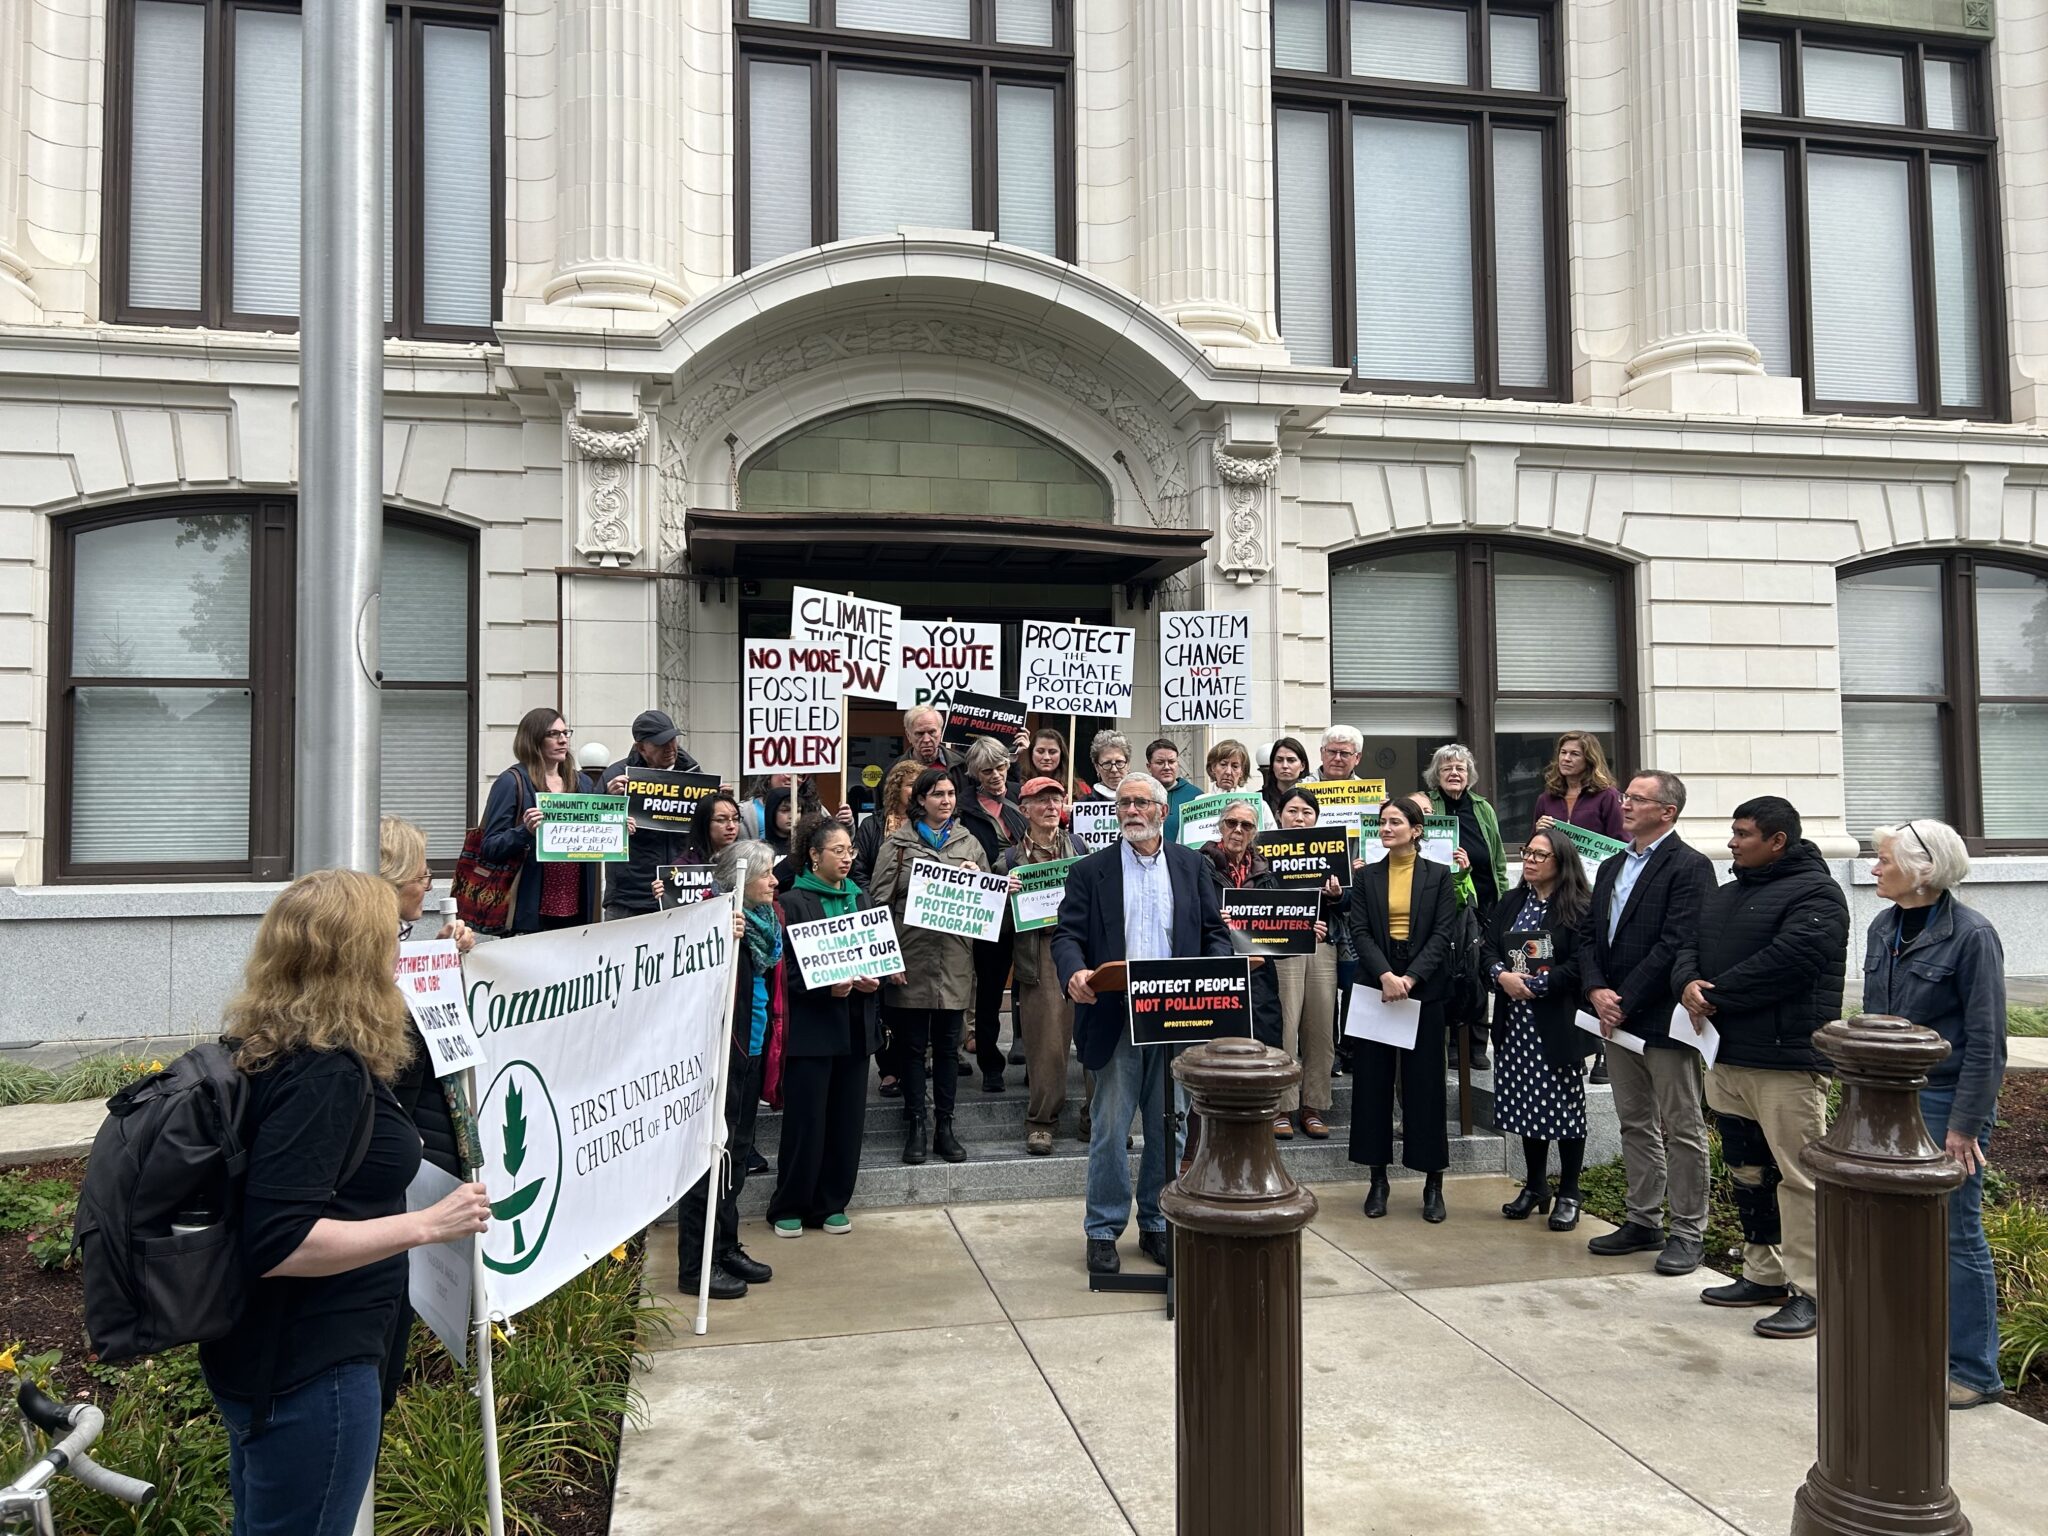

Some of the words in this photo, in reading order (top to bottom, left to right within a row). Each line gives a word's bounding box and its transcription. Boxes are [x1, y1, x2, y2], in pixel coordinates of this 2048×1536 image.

[801, 597, 892, 640] CLIMATE
[1166, 615, 1248, 639] SYSTEM
[922, 625, 975, 646] YOU
[1025, 624, 1131, 654] PROTECT
[748, 648, 782, 669] NO
[788, 648, 842, 673] MORE
[902, 645, 994, 670] POLLUTE
[1063, 652, 1087, 661] THE
[1165, 643, 1245, 667] CHANGE
[843, 661, 886, 692] OW
[1030, 658, 1122, 681] CLIMATE
[1190, 667, 1222, 677] NOT
[749, 676, 836, 702] FOSSIL
[925, 671, 969, 690] YOU
[1026, 676, 1132, 697] PROTECTION
[1165, 676, 1247, 698] CLIMATE
[952, 703, 991, 718] PROTECT
[992, 710, 1024, 724] PEOPLE
[1032, 695, 1118, 715] PROGRAM
[1166, 698, 1245, 722] CHANGE
[749, 706, 839, 734] FUELED
[950, 715, 967, 726] NOT
[749, 735, 841, 768] FOOLERY
[628, 781, 679, 797] PEOPLE
[1348, 785, 1382, 794] CLIMATE
[1358, 795, 1381, 804] MEAN
[541, 800, 589, 810] COMMUNITY
[591, 801, 625, 811] CLIMATE
[1075, 804, 1117, 816] PROTE
[1182, 800, 1222, 815] COMMUNITY
[600, 813, 624, 822] MEAN
[550, 825, 613, 835] AFFORDABLE
[551, 835, 580, 844] CLEAN
[582, 836, 618, 846] ENERGY
[1427, 829, 1454, 838] MEAN
[1309, 840, 1345, 854] OVER
[1272, 857, 1331, 872] PROFITS.
[913, 862, 977, 887] PROTECT
[979, 876, 1009, 893] OUR
[926, 882, 983, 905] CLIMATE
[914, 896, 995, 923] PROTECTION
[1225, 905, 1273, 916] PROTECT
[1276, 906, 1316, 916] PEOPLE
[792, 917, 855, 941] PROTECT
[861, 910, 889, 927] OUR
[921, 912, 983, 935] PROGRAM
[1228, 920, 1249, 930] NOT
[1252, 920, 1311, 930] POLLUTERS.
[817, 929, 877, 951] CLIMATE
[396, 955, 430, 974] RTHWEST
[801, 947, 863, 969] PROTECT
[869, 940, 897, 957] OUR
[811, 956, 902, 984] COMMUNITIES
[414, 976, 427, 993] AND
[468, 955, 625, 1039] Community
[632, 943, 664, 992] For
[672, 926, 725, 978] Earth
[1131, 979, 1191, 995] PROTECT
[1195, 977, 1246, 992] PEOPLE
[1135, 998, 1160, 1013] NOT
[1164, 996, 1243, 1011] POLLUTERS.
[416, 1005, 447, 1030] HANDS
[442, 1003, 461, 1027] OFF
[437, 1037, 459, 1062] OUR
[570, 1088, 617, 1136] FIRST
[621, 1052, 703, 1110] UNITARIAN
[576, 1116, 645, 1176] CHURCH
[648, 1118, 660, 1138] OF
